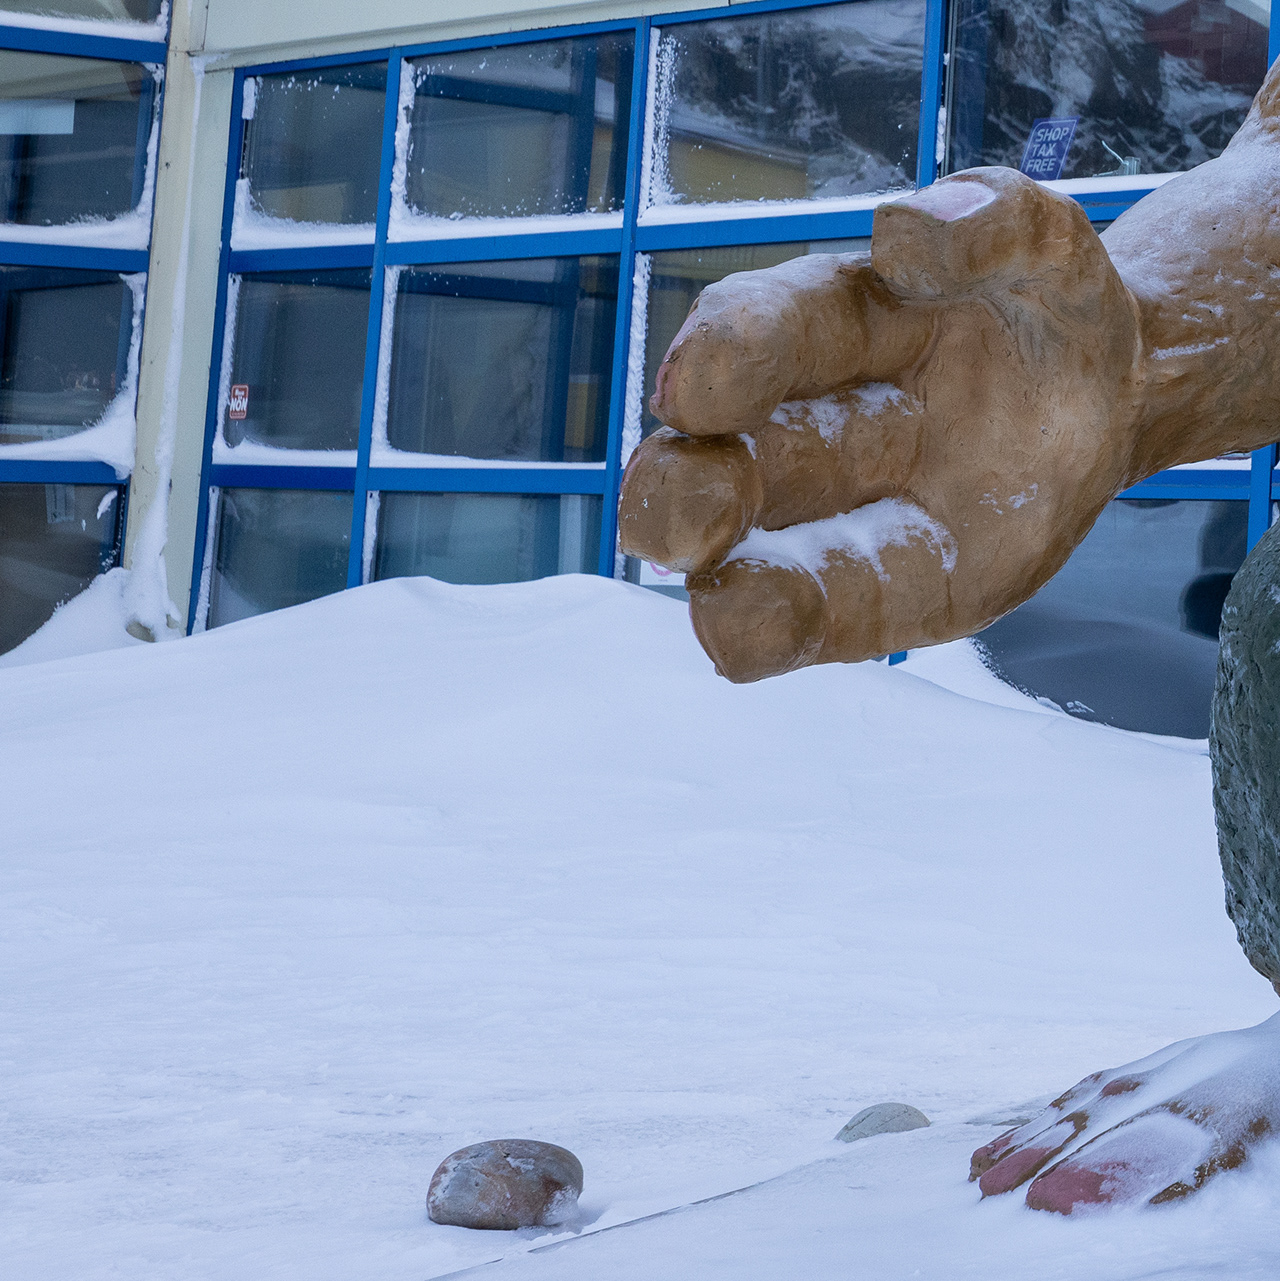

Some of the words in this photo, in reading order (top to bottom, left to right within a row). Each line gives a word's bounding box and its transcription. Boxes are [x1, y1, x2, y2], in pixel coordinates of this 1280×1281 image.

[1035, 127, 1070, 142] SHOP
[1032, 142, 1057, 157] TAX
[1025, 158, 1057, 172] FREE
